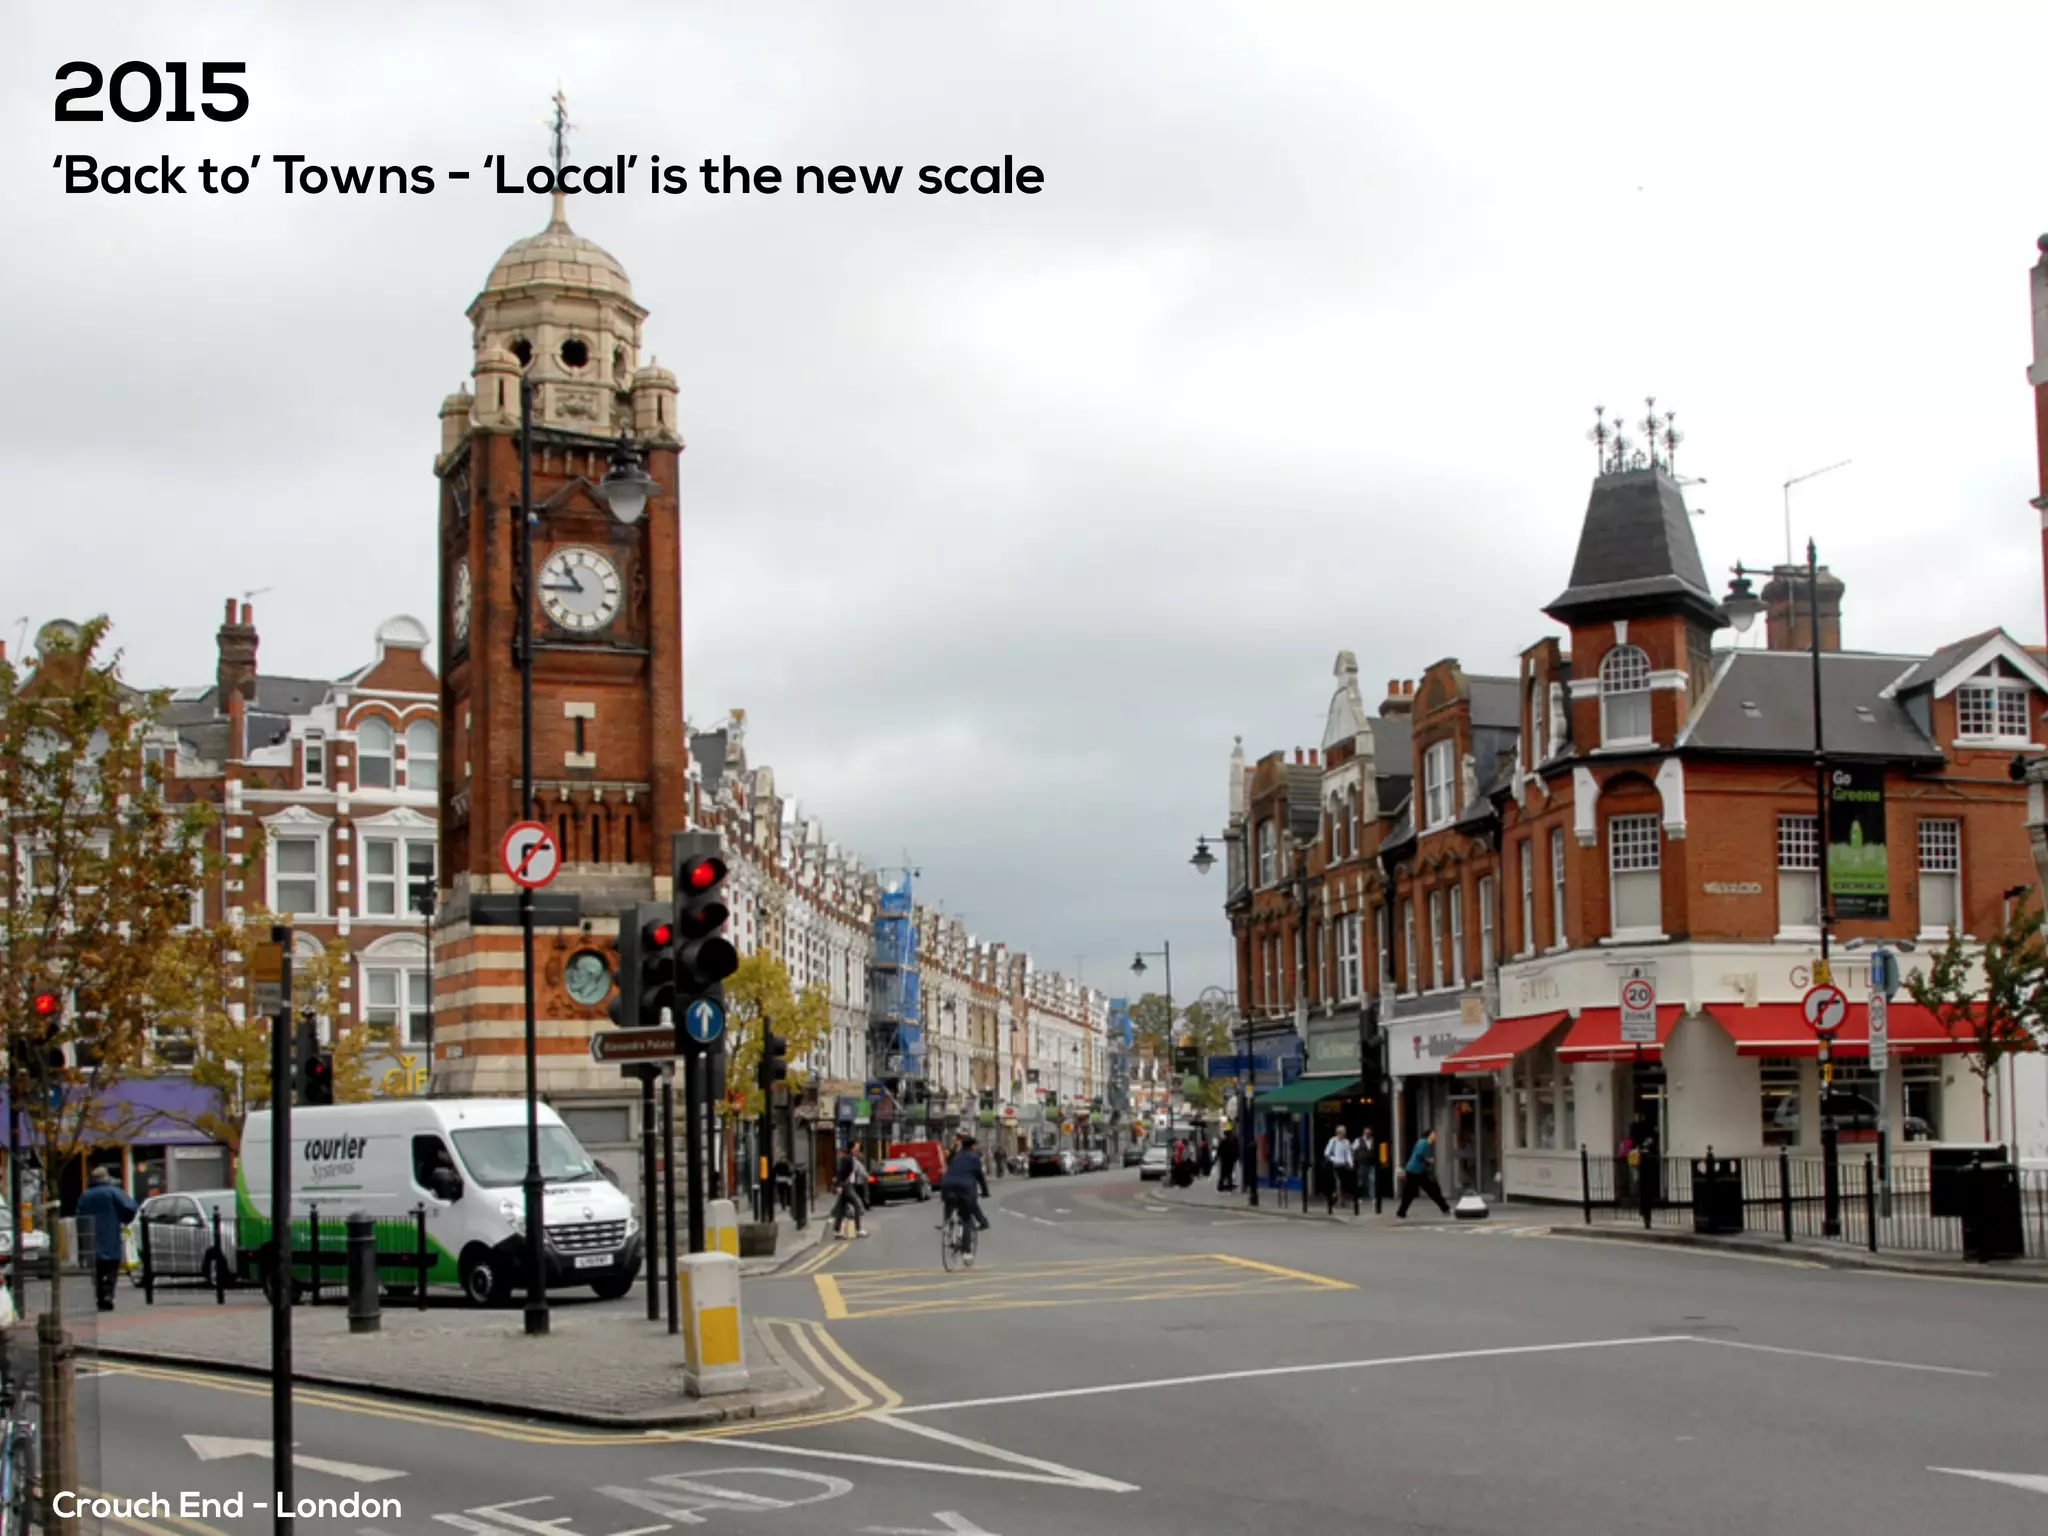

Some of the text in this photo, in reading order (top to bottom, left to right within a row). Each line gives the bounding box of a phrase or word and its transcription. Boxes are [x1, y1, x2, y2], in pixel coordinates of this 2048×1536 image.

[1832, 770, 1851, 785] Go
[1832, 788, 1880, 801] Greene
[1629, 988, 1649, 1002] 20
[1625, 1011, 1653, 1021] ZONE
[304, 1132, 368, 1161] courier
